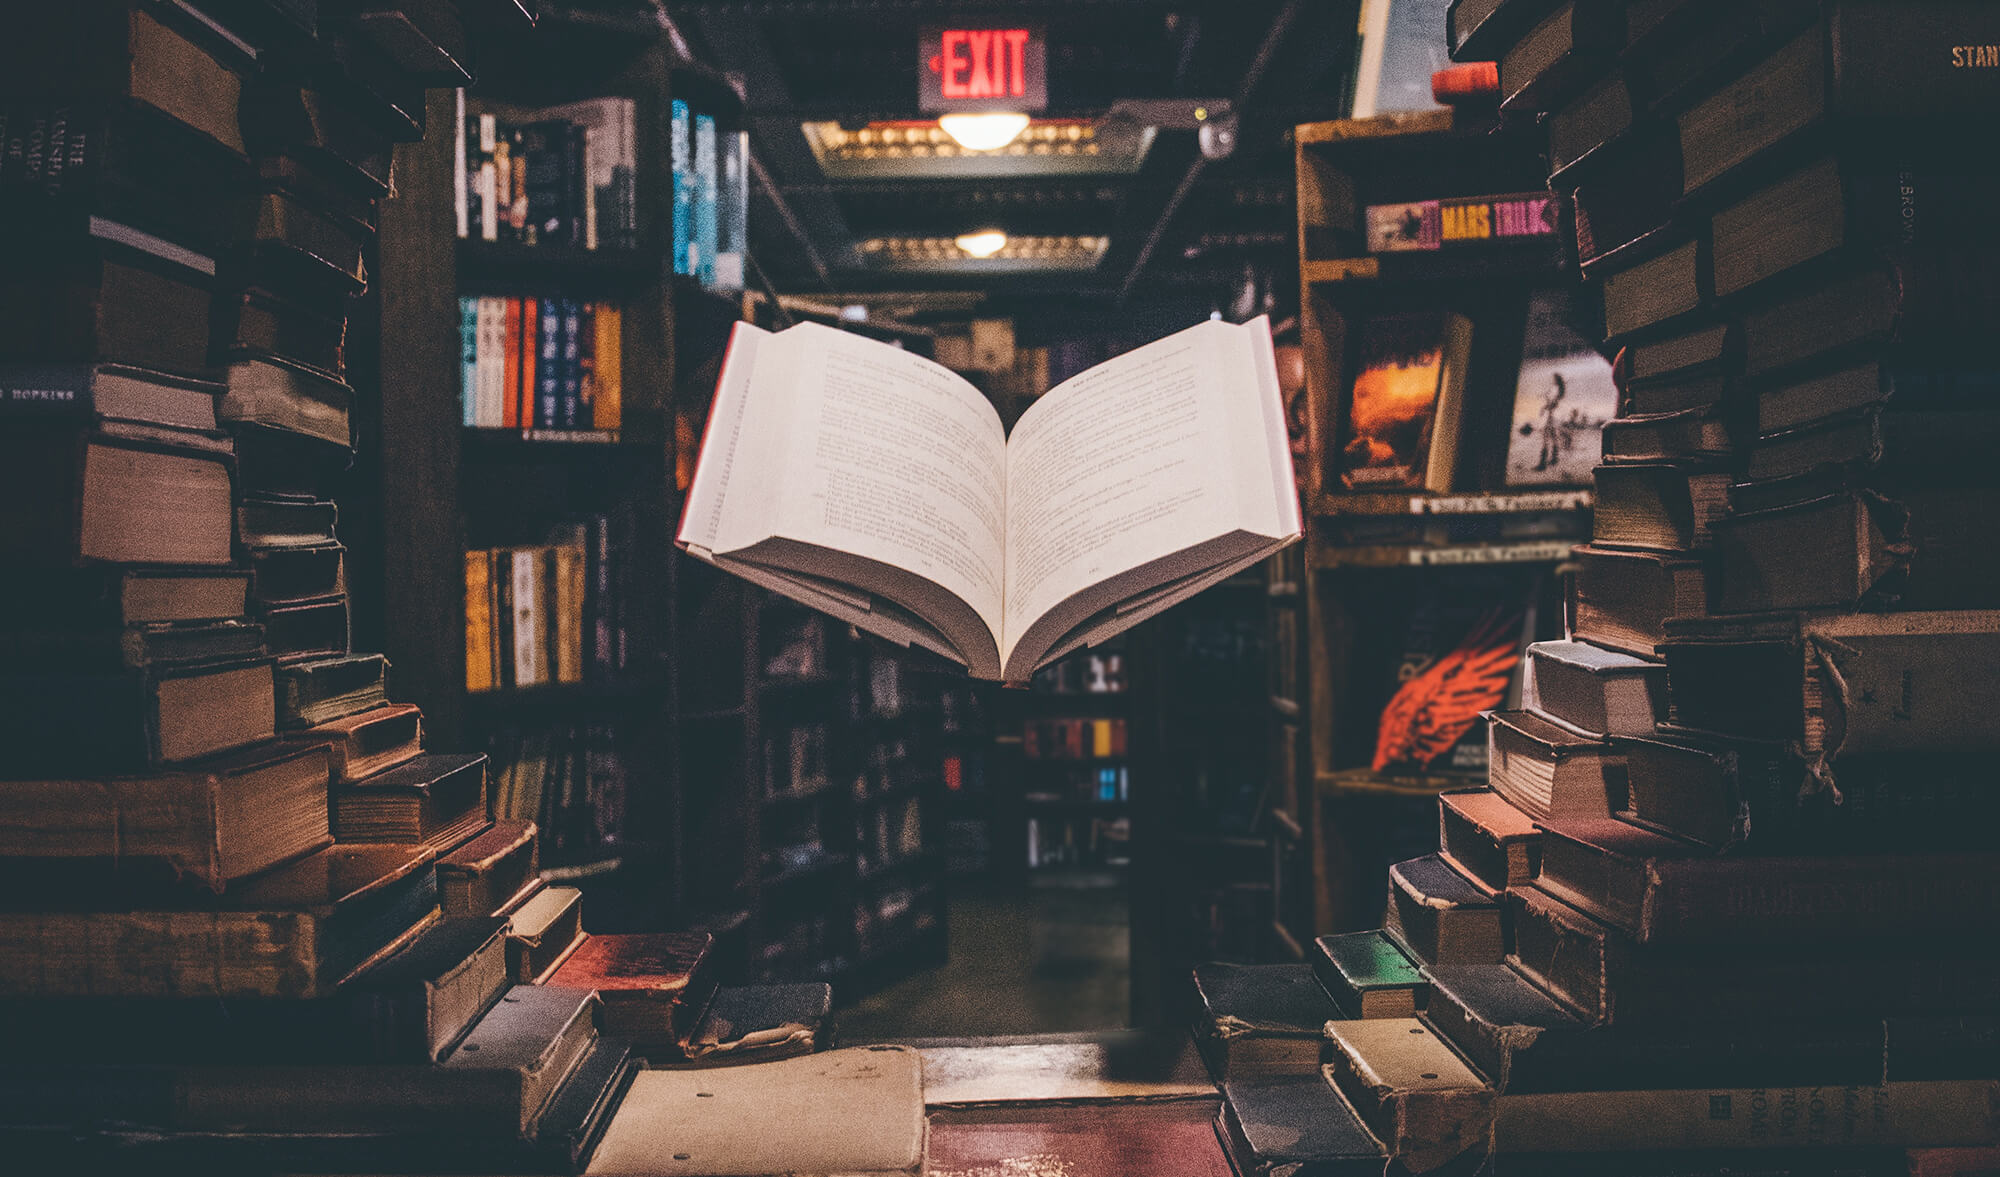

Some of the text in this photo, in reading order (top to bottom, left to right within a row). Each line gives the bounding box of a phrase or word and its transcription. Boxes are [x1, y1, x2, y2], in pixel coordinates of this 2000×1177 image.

[942, 29, 1029, 98] EXIT
[1952, 45, 2000, 68] STAN
[1441, 204, 1490, 240] MARS
[13, 389, 74, 400] HOPKINS
